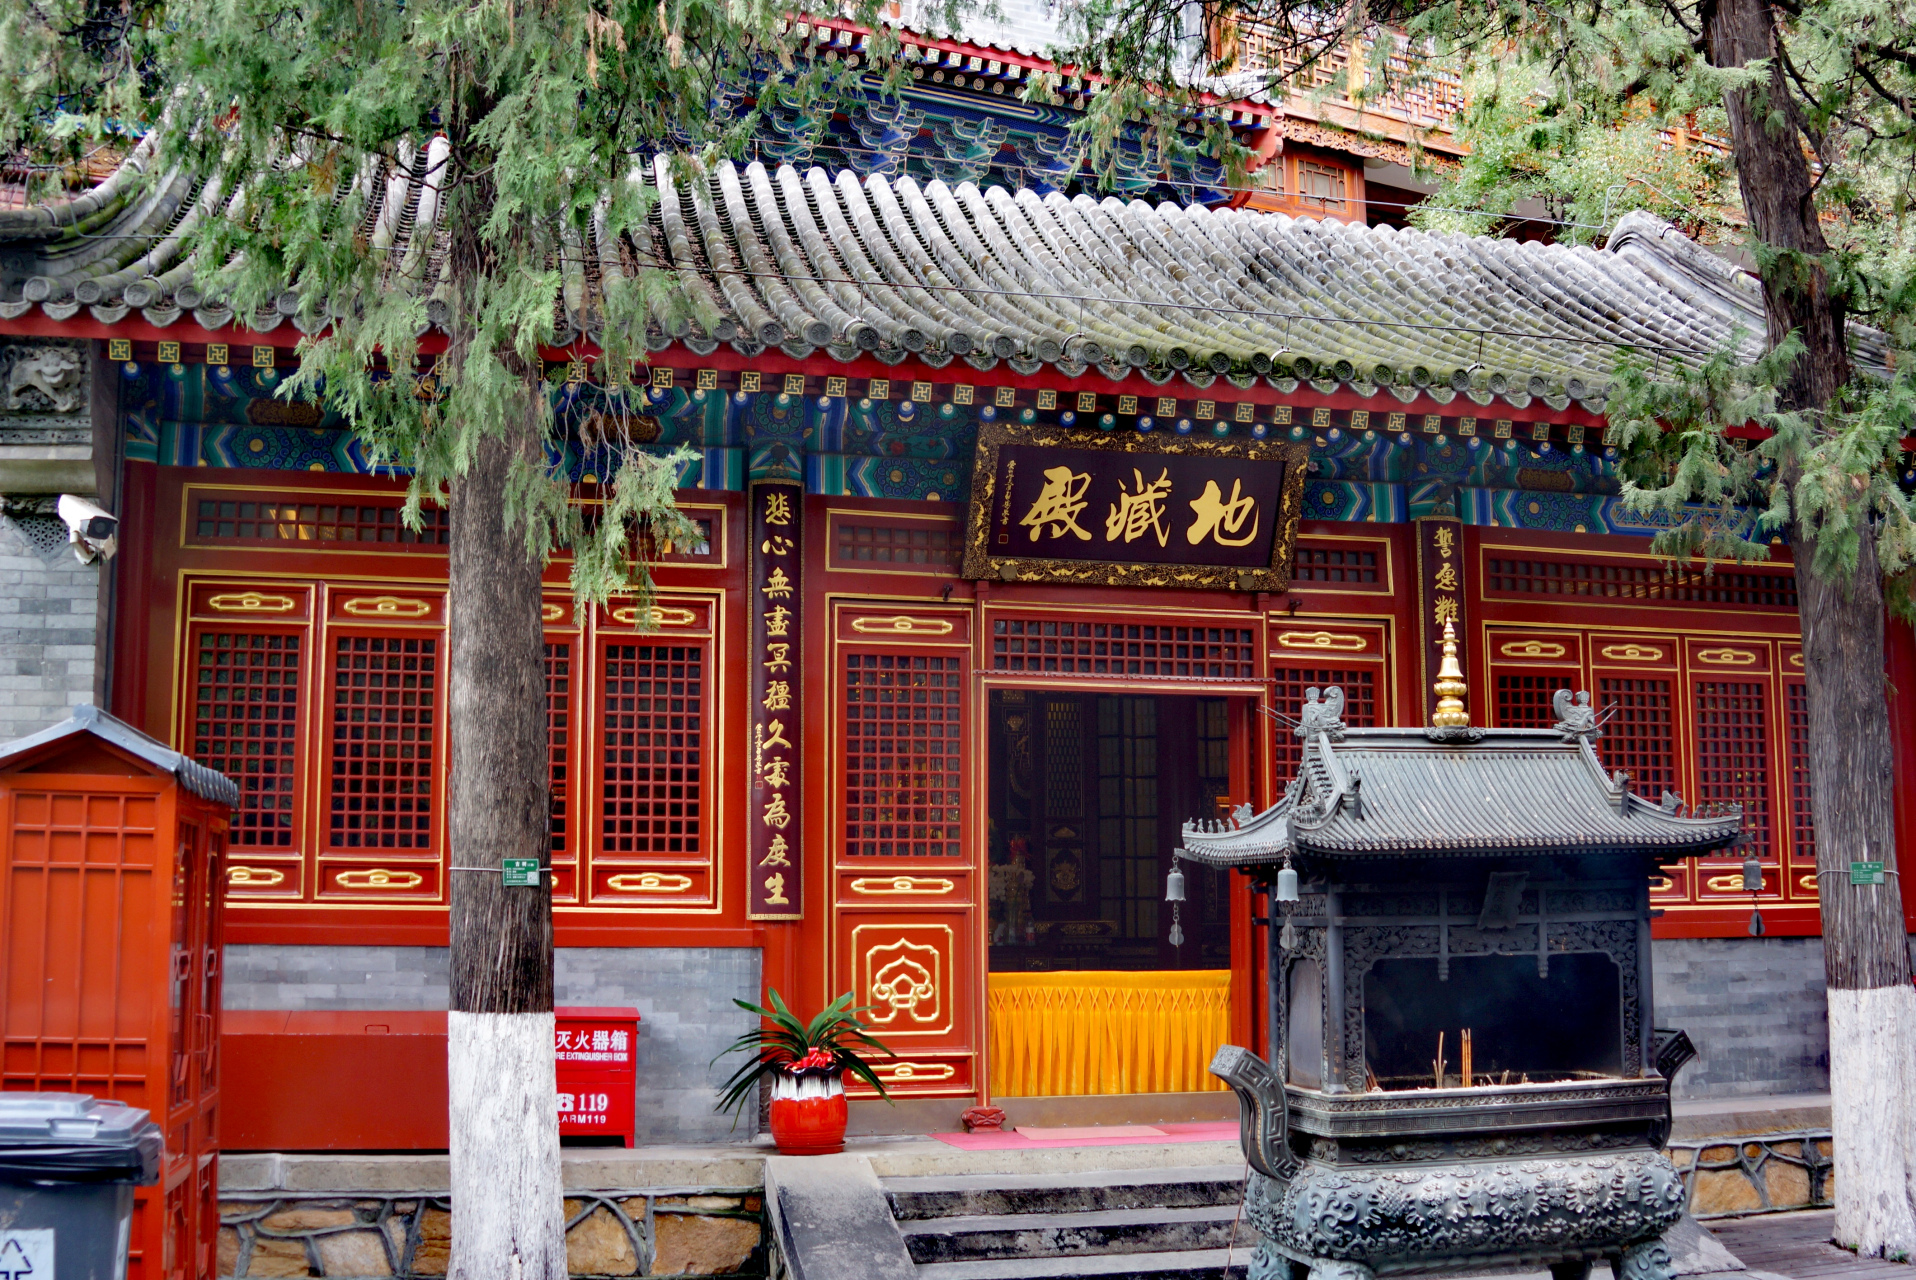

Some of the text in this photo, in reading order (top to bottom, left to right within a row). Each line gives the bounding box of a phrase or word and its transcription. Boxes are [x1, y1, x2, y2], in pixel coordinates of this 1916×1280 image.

[1019, 466, 1260, 547] 地藏殿
[1433, 526, 1460, 645] 誓愿難
[555, 1030, 629, 1051] 灭火器箱
[555, 1052, 628, 1062] RE EXTINGUISHER BOX
[578, 1093, 608, 1112] 119
[558, 1114, 607, 1124] ARM119
